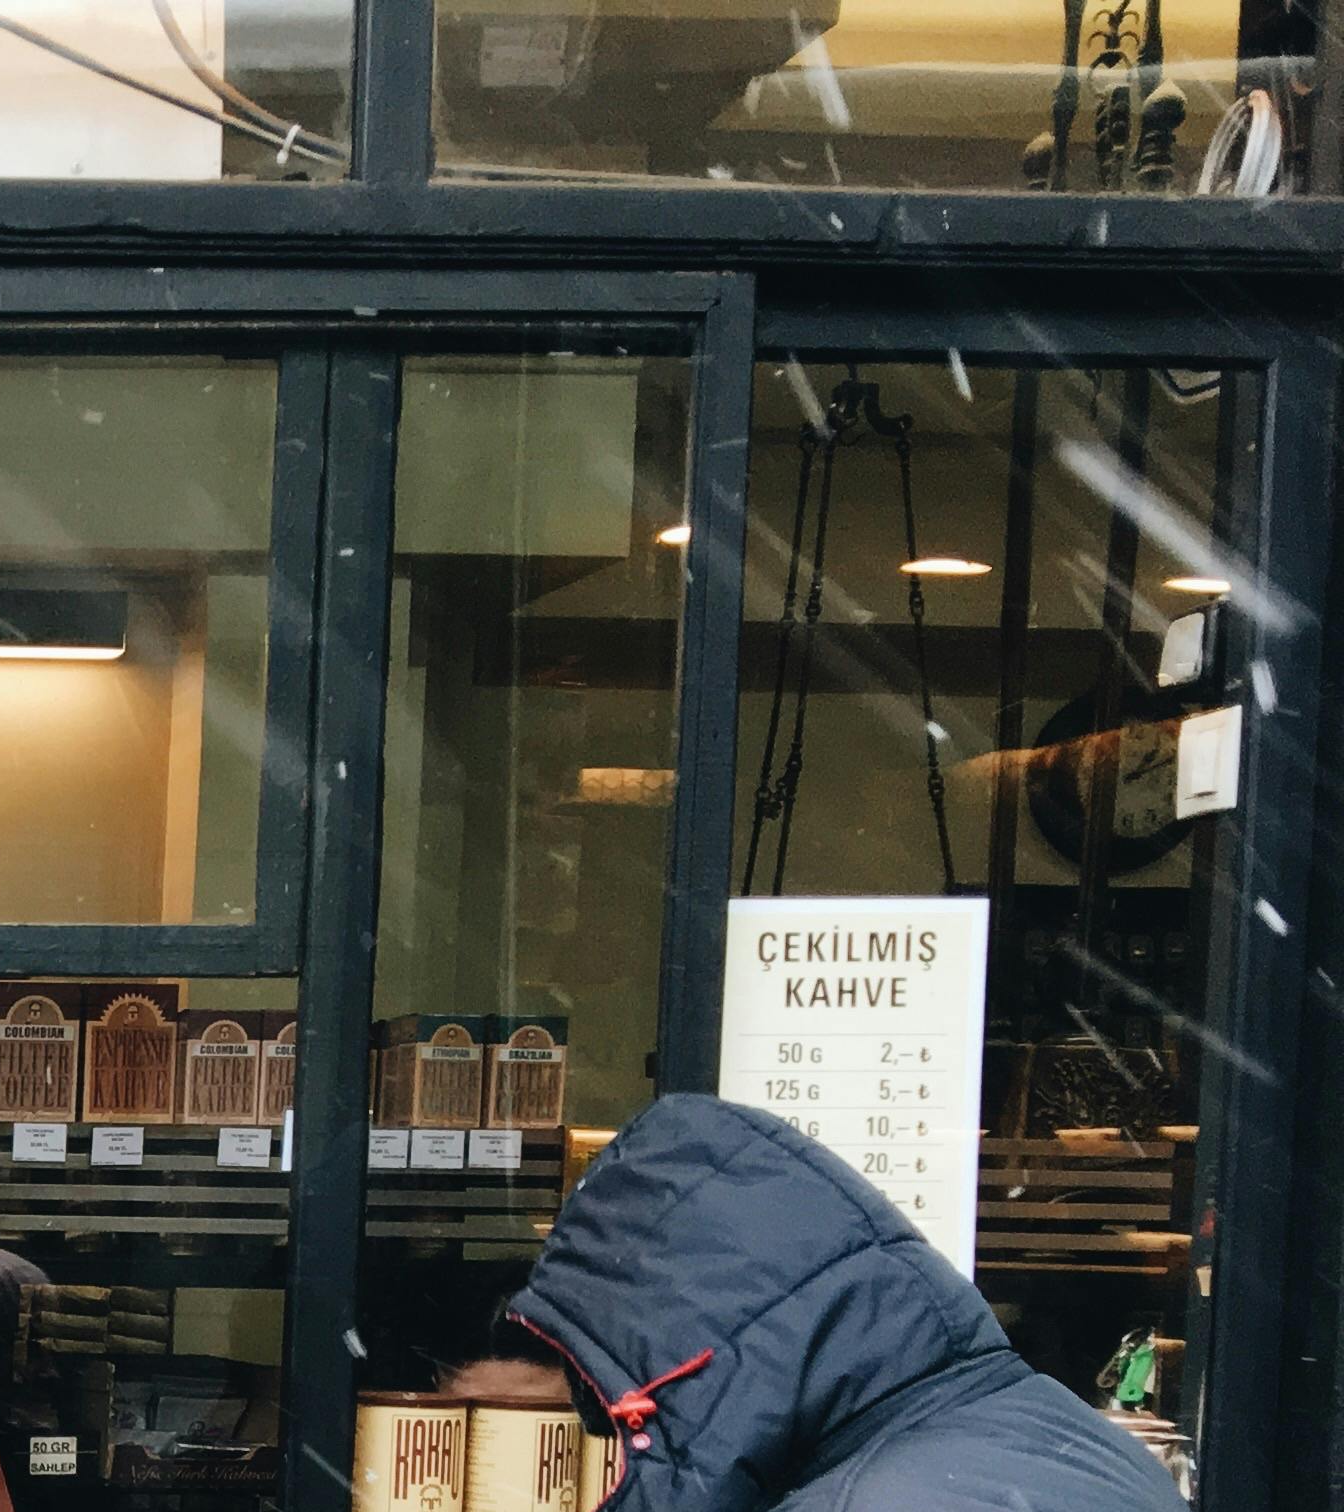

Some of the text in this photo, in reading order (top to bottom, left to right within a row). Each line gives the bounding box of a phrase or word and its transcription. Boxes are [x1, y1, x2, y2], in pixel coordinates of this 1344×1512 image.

[757, 925, 938, 972] ÇEKİLMİŞ
[785, 977, 907, 1008] KAHVE
[4, 1026, 65, 1039] COLOMBIAN
[200, 1045, 249, 1055] COLOMBIAN
[778, 1043, 803, 1064] 50
[810, 1049, 823, 1064] G
[765, 1080, 800, 1101] 125
[808, 1085, 820, 1101] G
[32, 1442, 48, 1454] 50
[30, 1462, 76, 1473] SAHLEP
[394, 1418, 462, 1500] KAKAO
[537, 1423, 578, 1504] KAK
